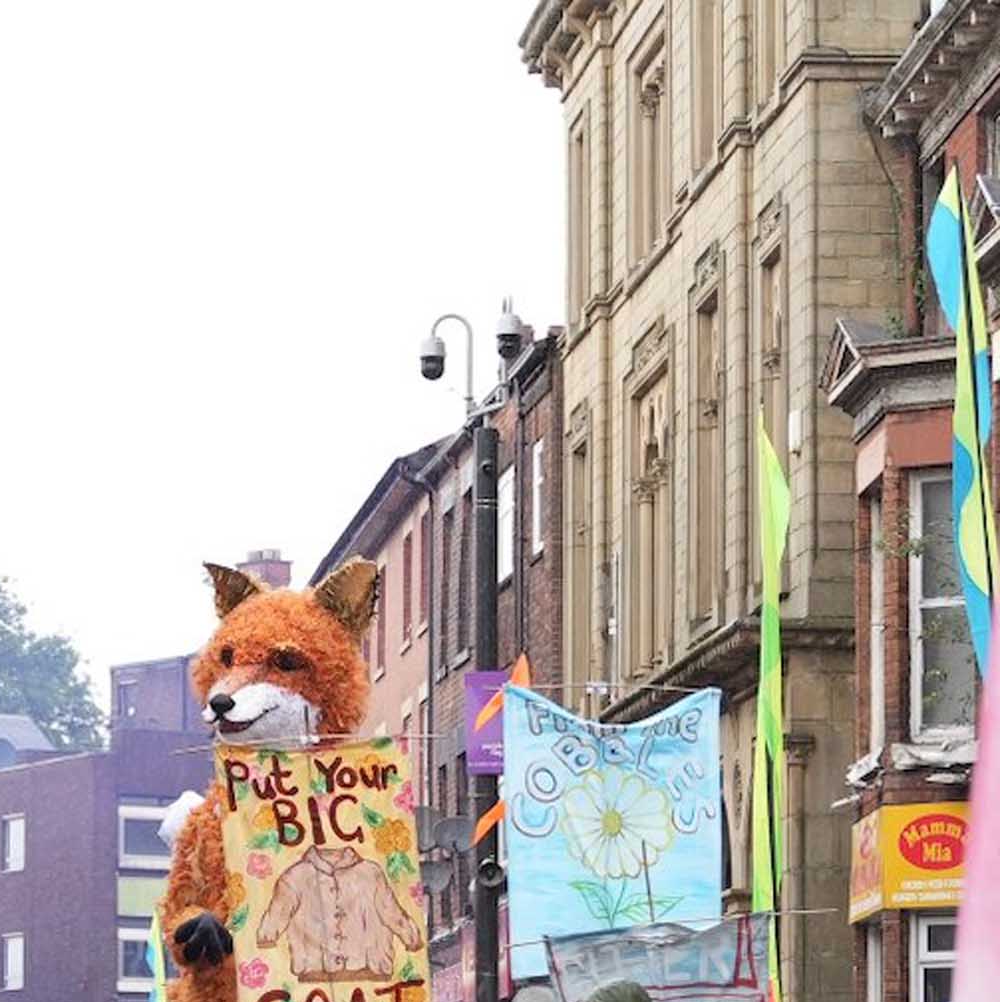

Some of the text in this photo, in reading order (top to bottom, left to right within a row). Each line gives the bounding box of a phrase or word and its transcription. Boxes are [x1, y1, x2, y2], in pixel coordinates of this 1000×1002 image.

[224, 755, 398, 812] Put Your
[271, 794, 364, 846] BIG
[922, 841, 953, 863] Mia
